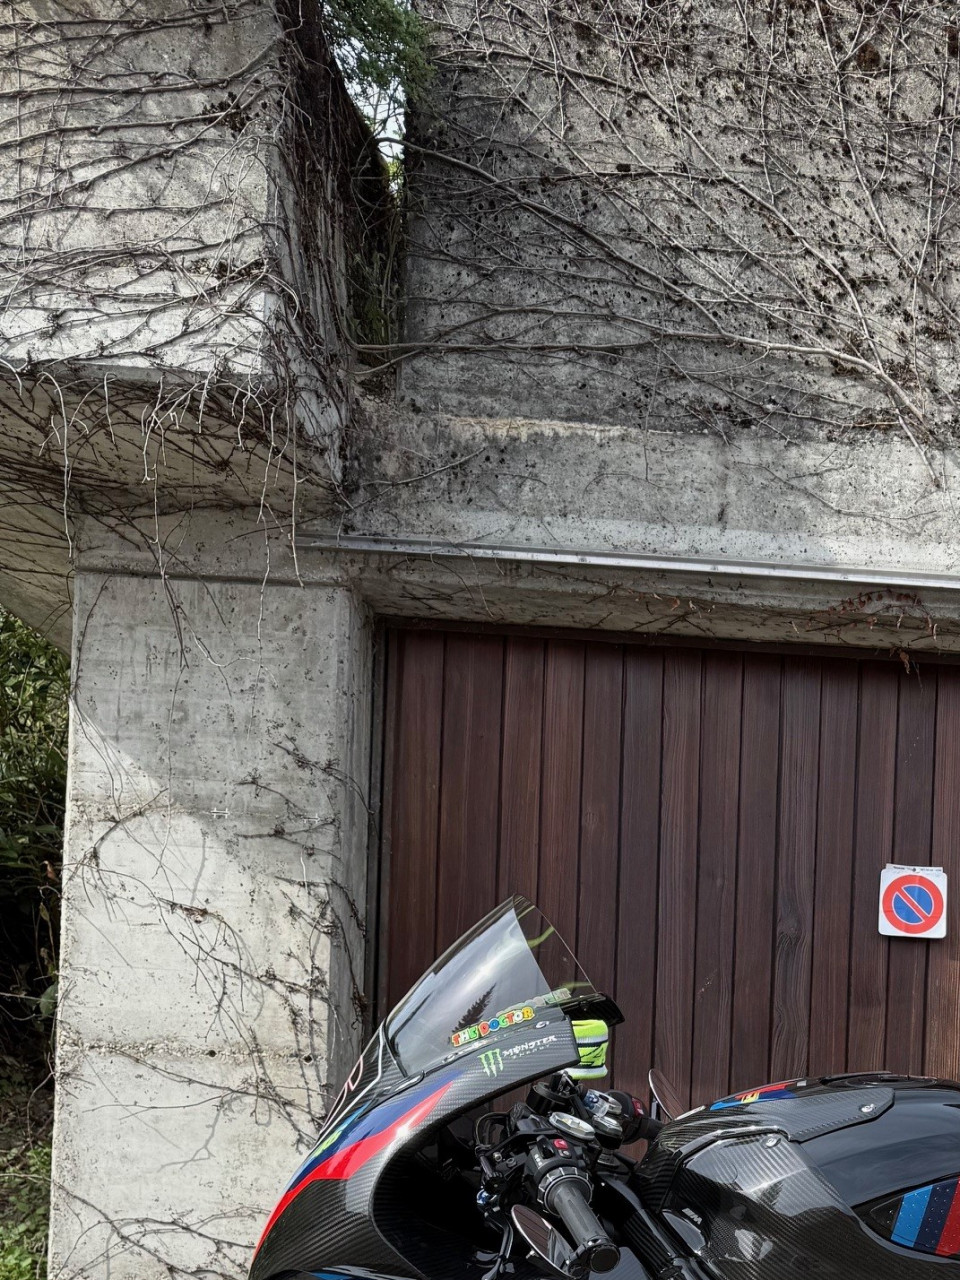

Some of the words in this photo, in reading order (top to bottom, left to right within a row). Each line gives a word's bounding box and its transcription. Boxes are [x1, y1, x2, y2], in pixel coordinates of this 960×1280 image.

[452, 1025, 478, 1046] THE
[480, 1007, 535, 1036] DOCTOR
[502, 1034, 558, 1057] MONSTER
